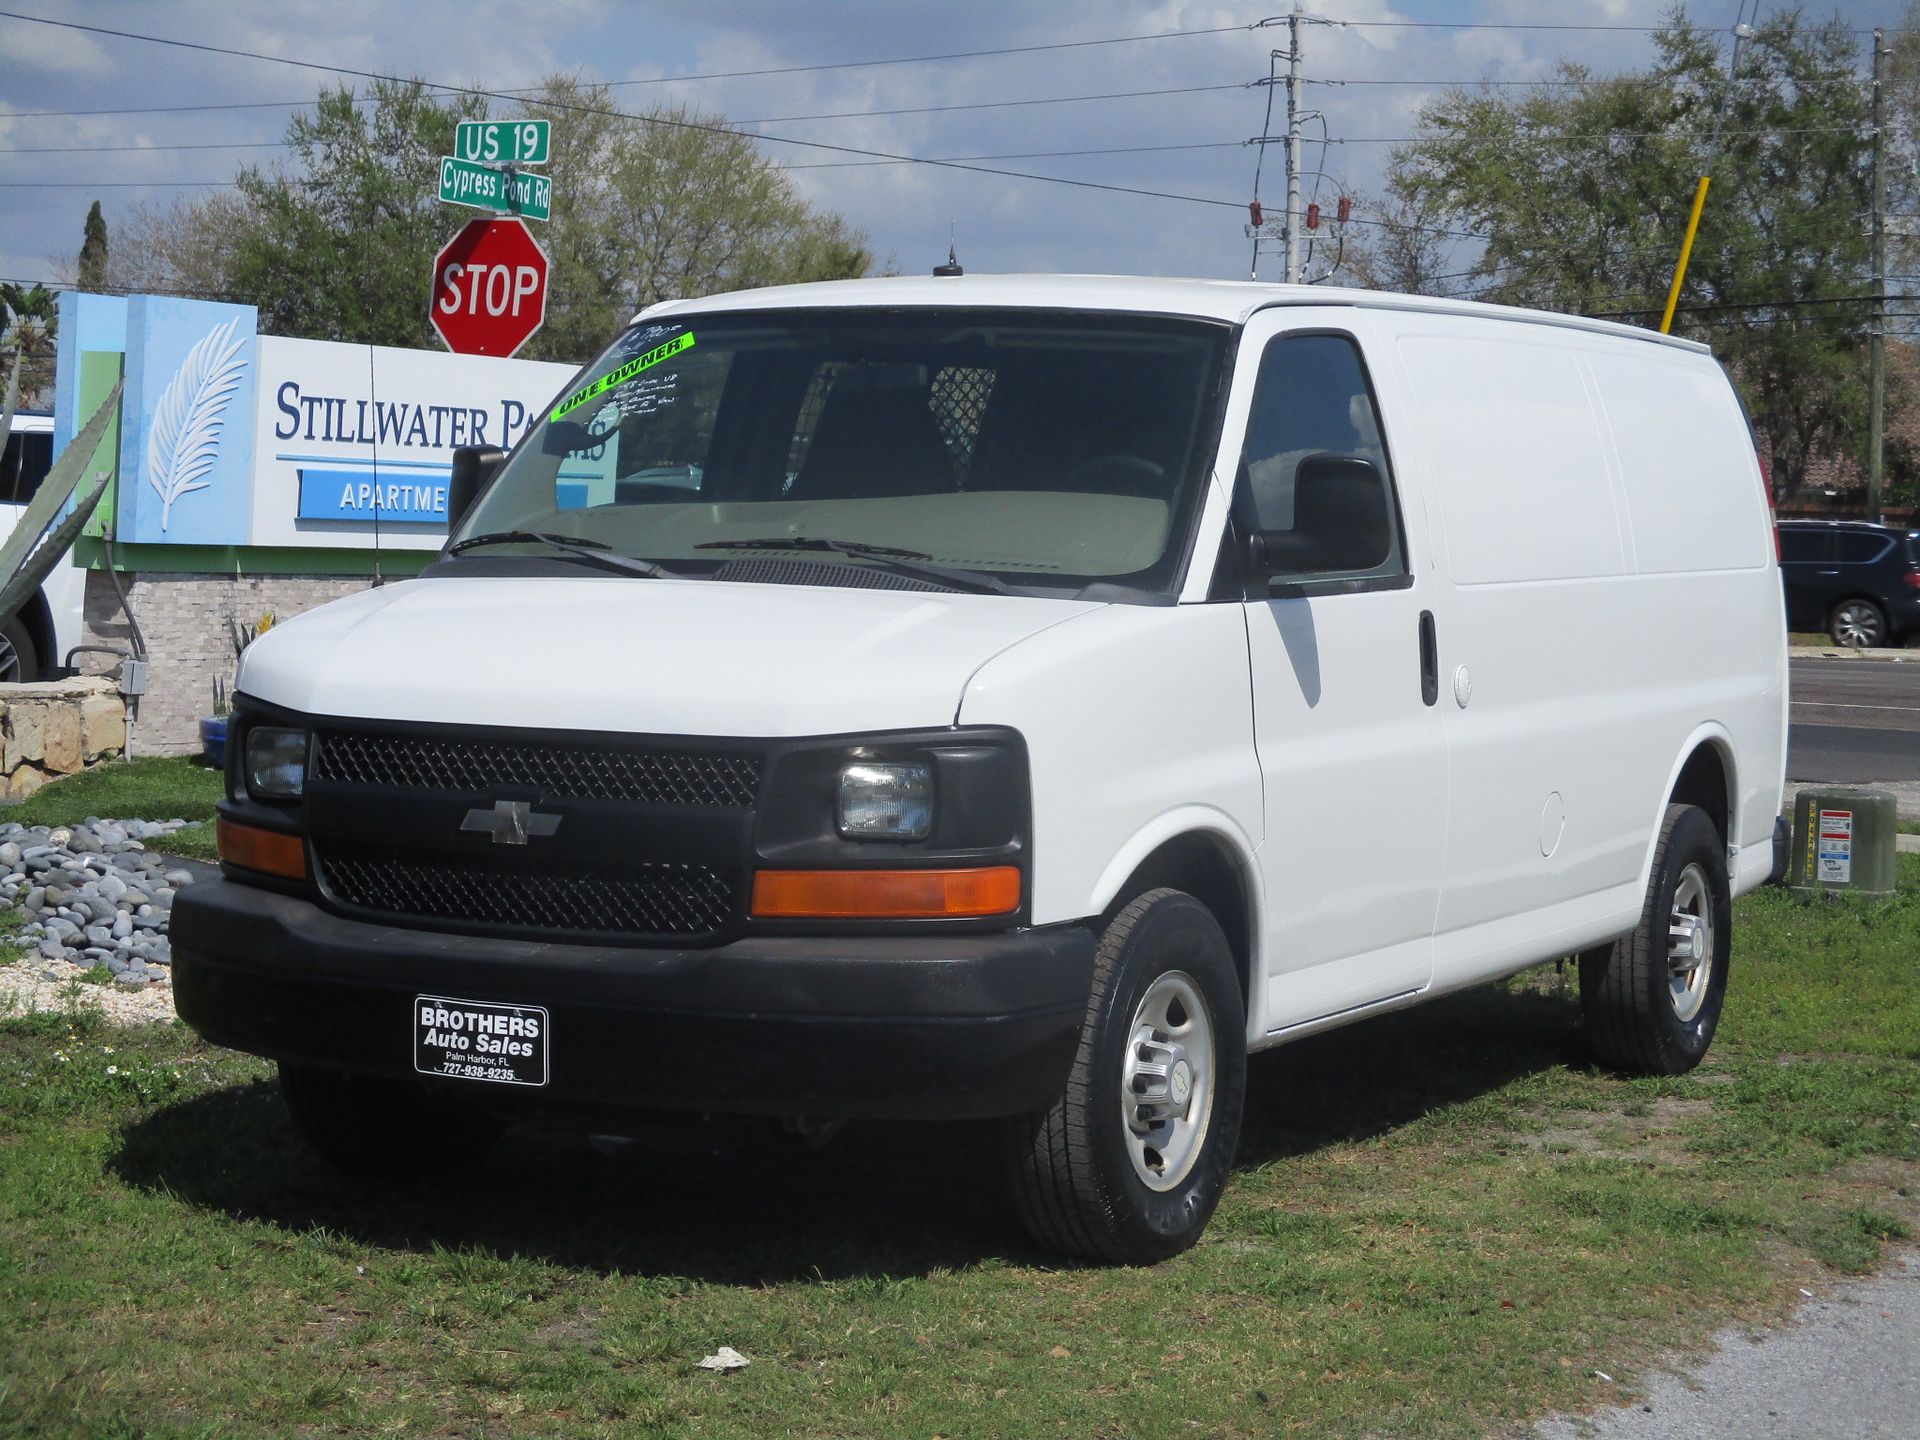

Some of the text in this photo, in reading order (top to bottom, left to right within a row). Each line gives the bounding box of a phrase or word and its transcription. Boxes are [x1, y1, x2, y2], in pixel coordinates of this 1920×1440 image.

[466, 124, 538, 160] US 19
[442, 161, 549, 208] Cypress Pond Rd
[439, 263, 539, 317] STOP
[559, 382, 601, 415] ONE
[606, 337, 684, 386] OWNER
[275, 381, 489, 449] STILLWATER
[339, 483, 446, 514] APARTME
[421, 1006, 539, 1038] BROTHERS
[424, 1028, 533, 1057] Auto Sales
[445, 1051, 510, 1067] Palm Harbor, FL
[443, 1062, 514, 1081] 727-938-9235
